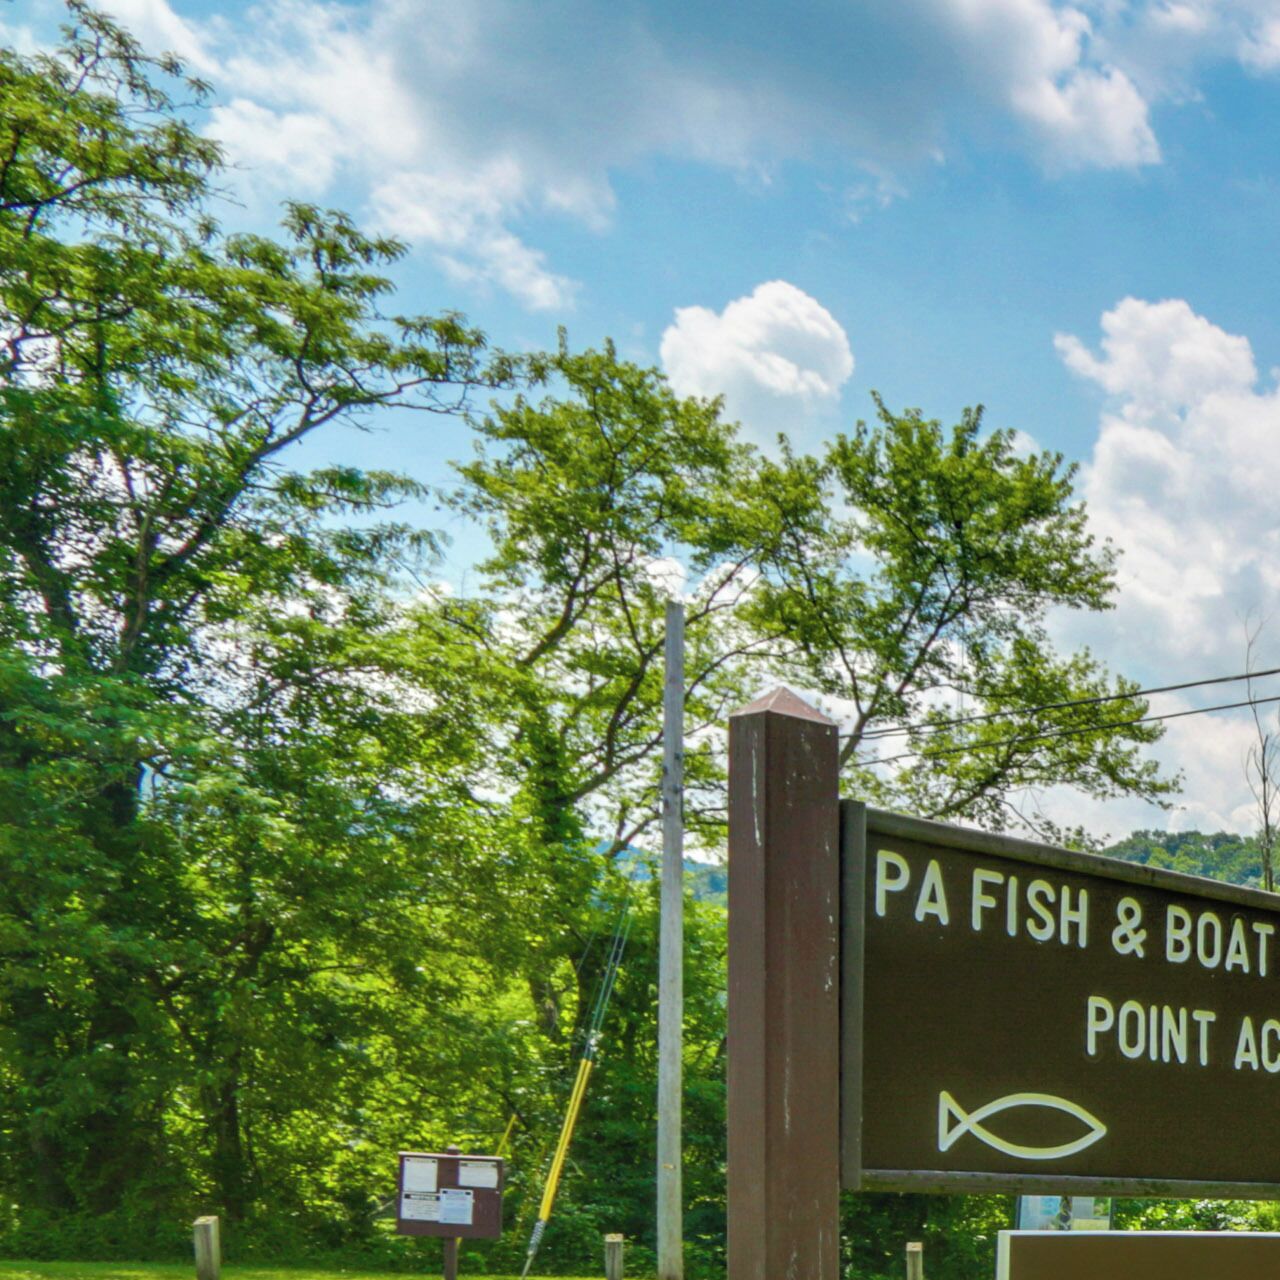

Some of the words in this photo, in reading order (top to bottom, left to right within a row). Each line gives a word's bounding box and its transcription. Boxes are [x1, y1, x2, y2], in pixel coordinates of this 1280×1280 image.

[875, 850, 949, 926] PA
[972, 868, 1088, 948] FISH
[1112, 898, 1147, 958] &
[1166, 905, 1274, 977] BOAT
[1087, 996, 1216, 1066] POINT
